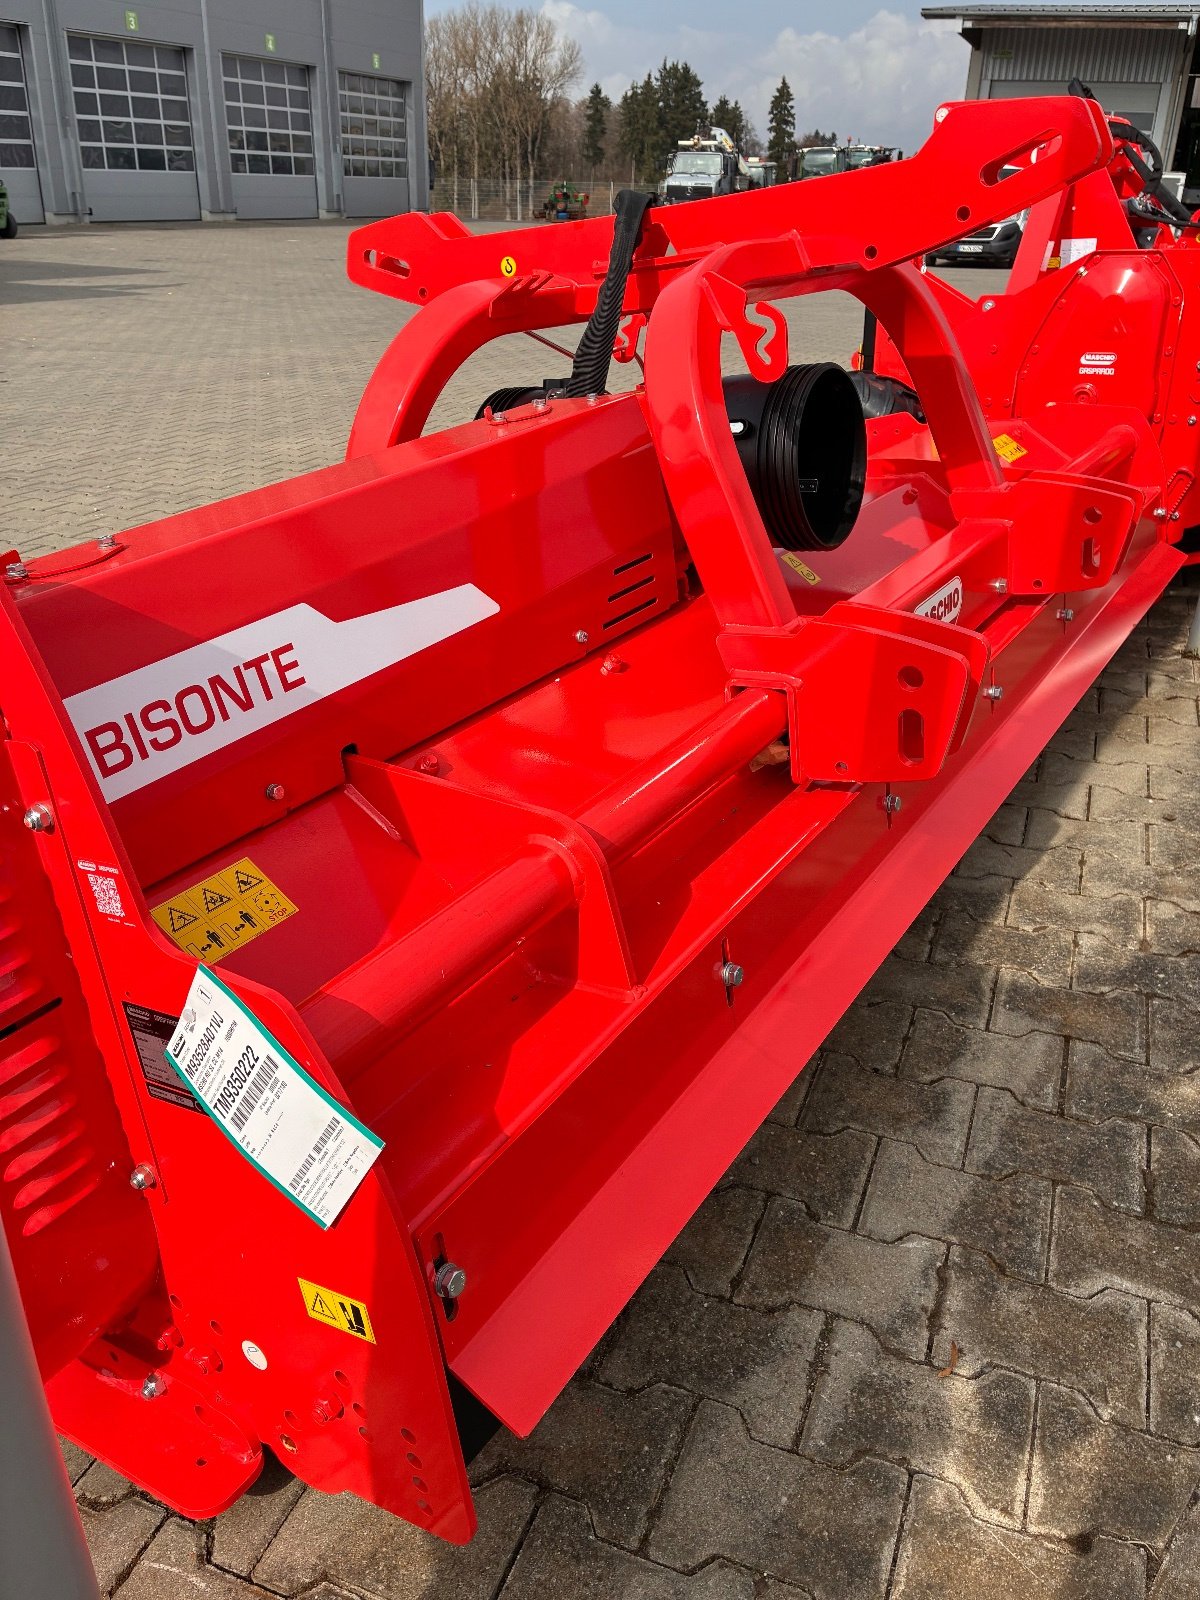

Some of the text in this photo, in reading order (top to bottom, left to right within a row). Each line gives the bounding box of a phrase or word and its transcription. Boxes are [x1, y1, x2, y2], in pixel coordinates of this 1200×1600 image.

[128, 17, 136, 30] 3
[924, 587, 960, 621] SCHIO
[84, 642, 307, 779] BISONTE
[268, 907, 288, 922] STOP
[199, 988, 211, 1000] 1
[184, 1010, 224, 1080] M93528A01VJ
[213, 1045, 260, 1119] TM9350222
